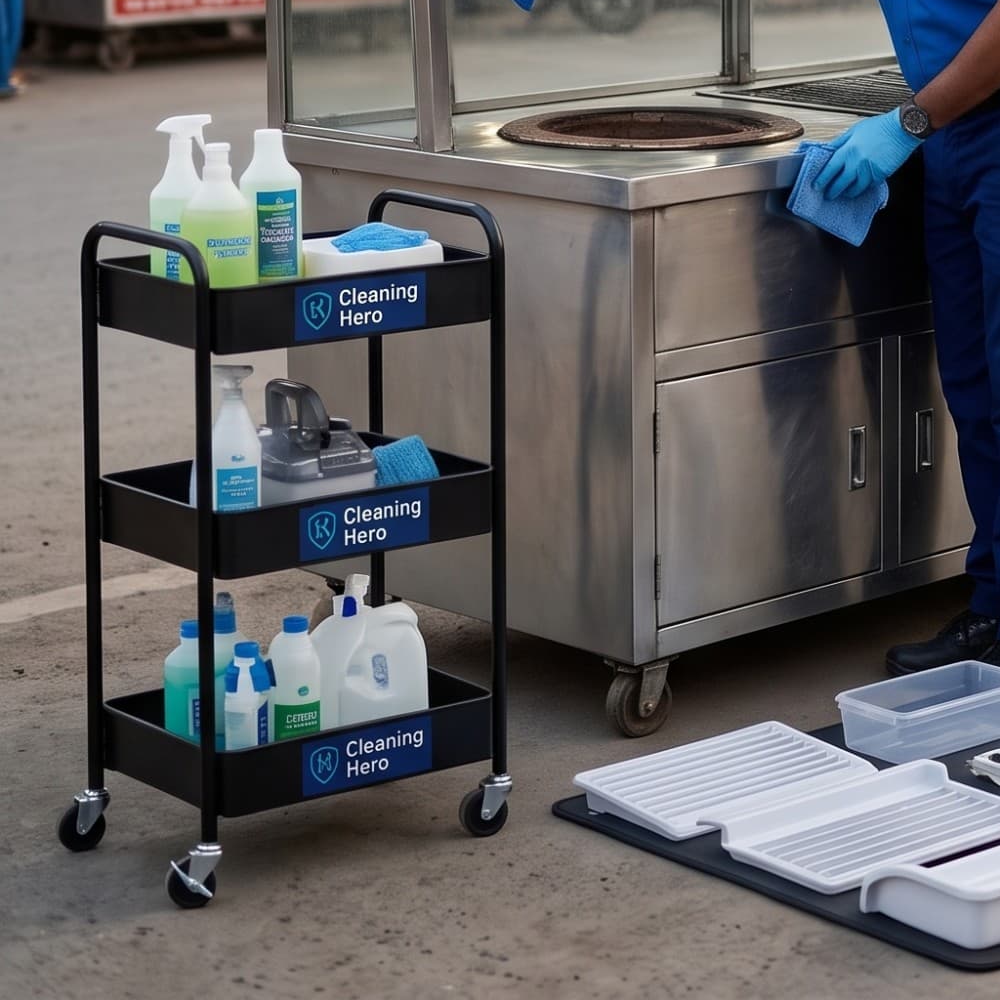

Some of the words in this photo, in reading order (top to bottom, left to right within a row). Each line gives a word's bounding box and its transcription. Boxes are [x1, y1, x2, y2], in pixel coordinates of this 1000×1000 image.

[339, 283, 418, 303] Cleaning
[339, 309, 383, 327] Hero
[344, 500, 421, 525] Cleaning
[344, 527, 387, 547] Hero
[346, 729, 424, 757] Cleaning
[347, 758, 389, 778] Hero
